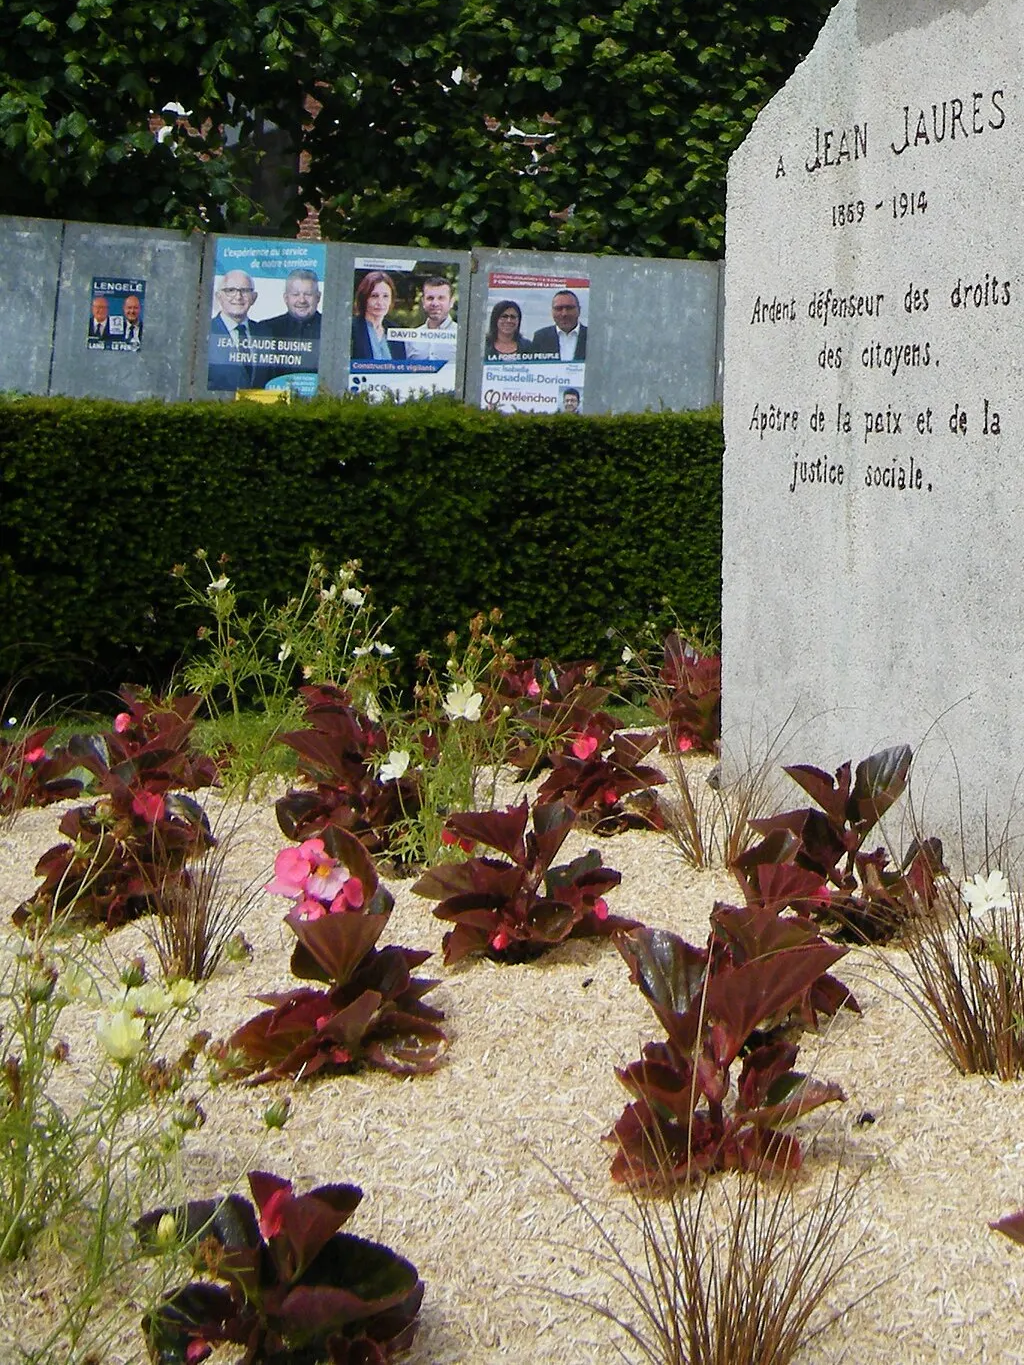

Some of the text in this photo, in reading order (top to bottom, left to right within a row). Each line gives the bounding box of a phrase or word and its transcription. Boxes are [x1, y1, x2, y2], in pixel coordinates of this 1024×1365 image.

[775, 89, 1006, 179] A JEAN JAURES
[892, 191, 928, 219] 1914
[281, 247, 308, 256] service
[250, 258, 318, 268] de notre territoire
[94, 281, 143, 292] LENGELÉ
[750, 272, 1011, 327] Ardent défenseur des droits
[390, 330, 456, 340] DAVID MONGIN
[217, 338, 313, 352] JEAN-CLAUDE BUISINE
[259, 353, 302, 365] MENTION
[498, 353, 522, 361] FORCE
[534, 352, 560, 360] PEUPLE
[817, 339, 940, 377] des citoyens.
[352, 362, 436, 372] Constructifs et vigilants
[501, 391, 557, 403] Mélenchon
[749, 398, 1001, 444] Apôtre de la paix et de la
[790, 452, 933, 493] justice sociale.
